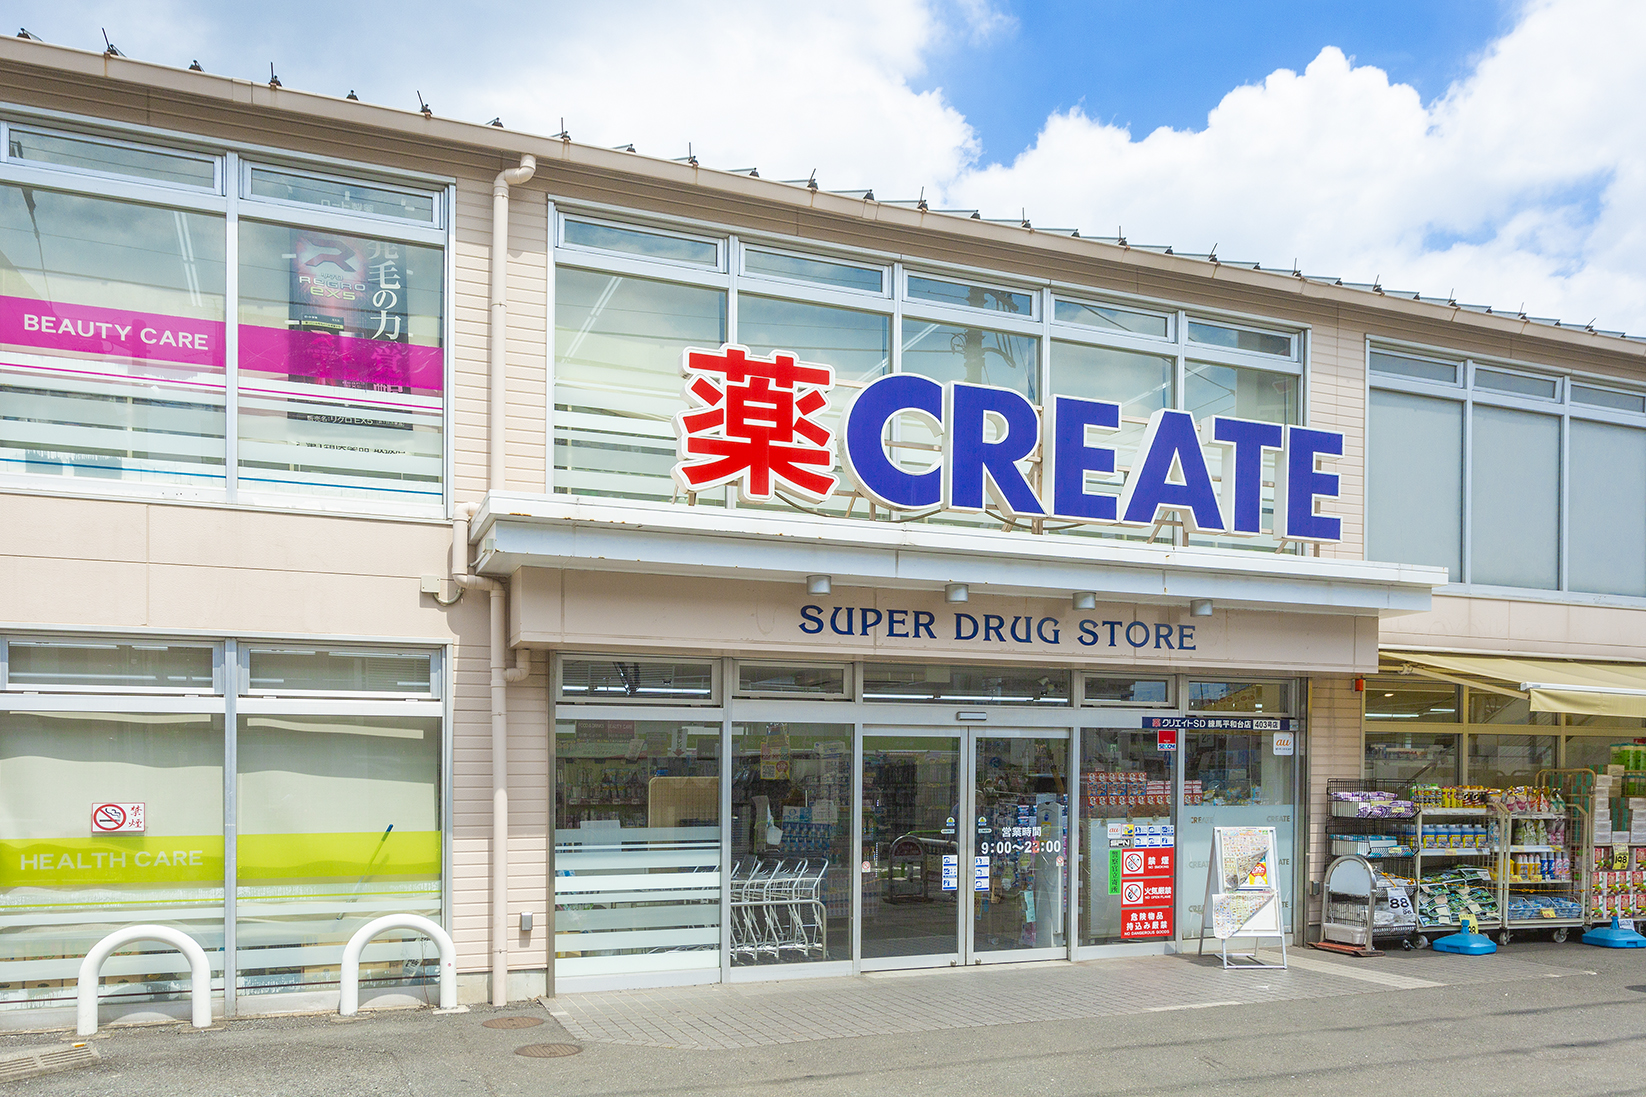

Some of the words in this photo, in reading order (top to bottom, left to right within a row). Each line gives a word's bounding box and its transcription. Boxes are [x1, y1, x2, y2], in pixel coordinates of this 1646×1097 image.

[24, 314, 132, 341] BEAUTY
[140, 327, 209, 350] CARE
[676, 346, 839, 499] 薬
[844, 373, 1345, 541] CREATE
[798, 604, 938, 640] SUPER
[953, 612, 1061, 645] DRUG
[1077, 619, 1197, 651] STORE
[1162, 719, 1206, 728] クリエイトSD
[1207, 720, 1252, 730] 練馬平和台店
[1254, 720, 1279, 729] 403号店
[1275, 738, 1291, 747] au
[128, 805, 143, 829] 禁煙
[1266, 815, 1290, 823] CREATE
[1001, 827, 1042, 838] 営業時間
[20, 852, 126, 870] HEALTH
[134, 850, 203, 867] CARE
[1148, 856, 1169, 866] 禁煙
[1144, 887, 1172, 896] 火気厳禁
[1389, 897, 1409, 909] 88
[1131, 911, 1164, 921] 危険物品
[1126, 921, 1168, 931] 持込み厳禁
